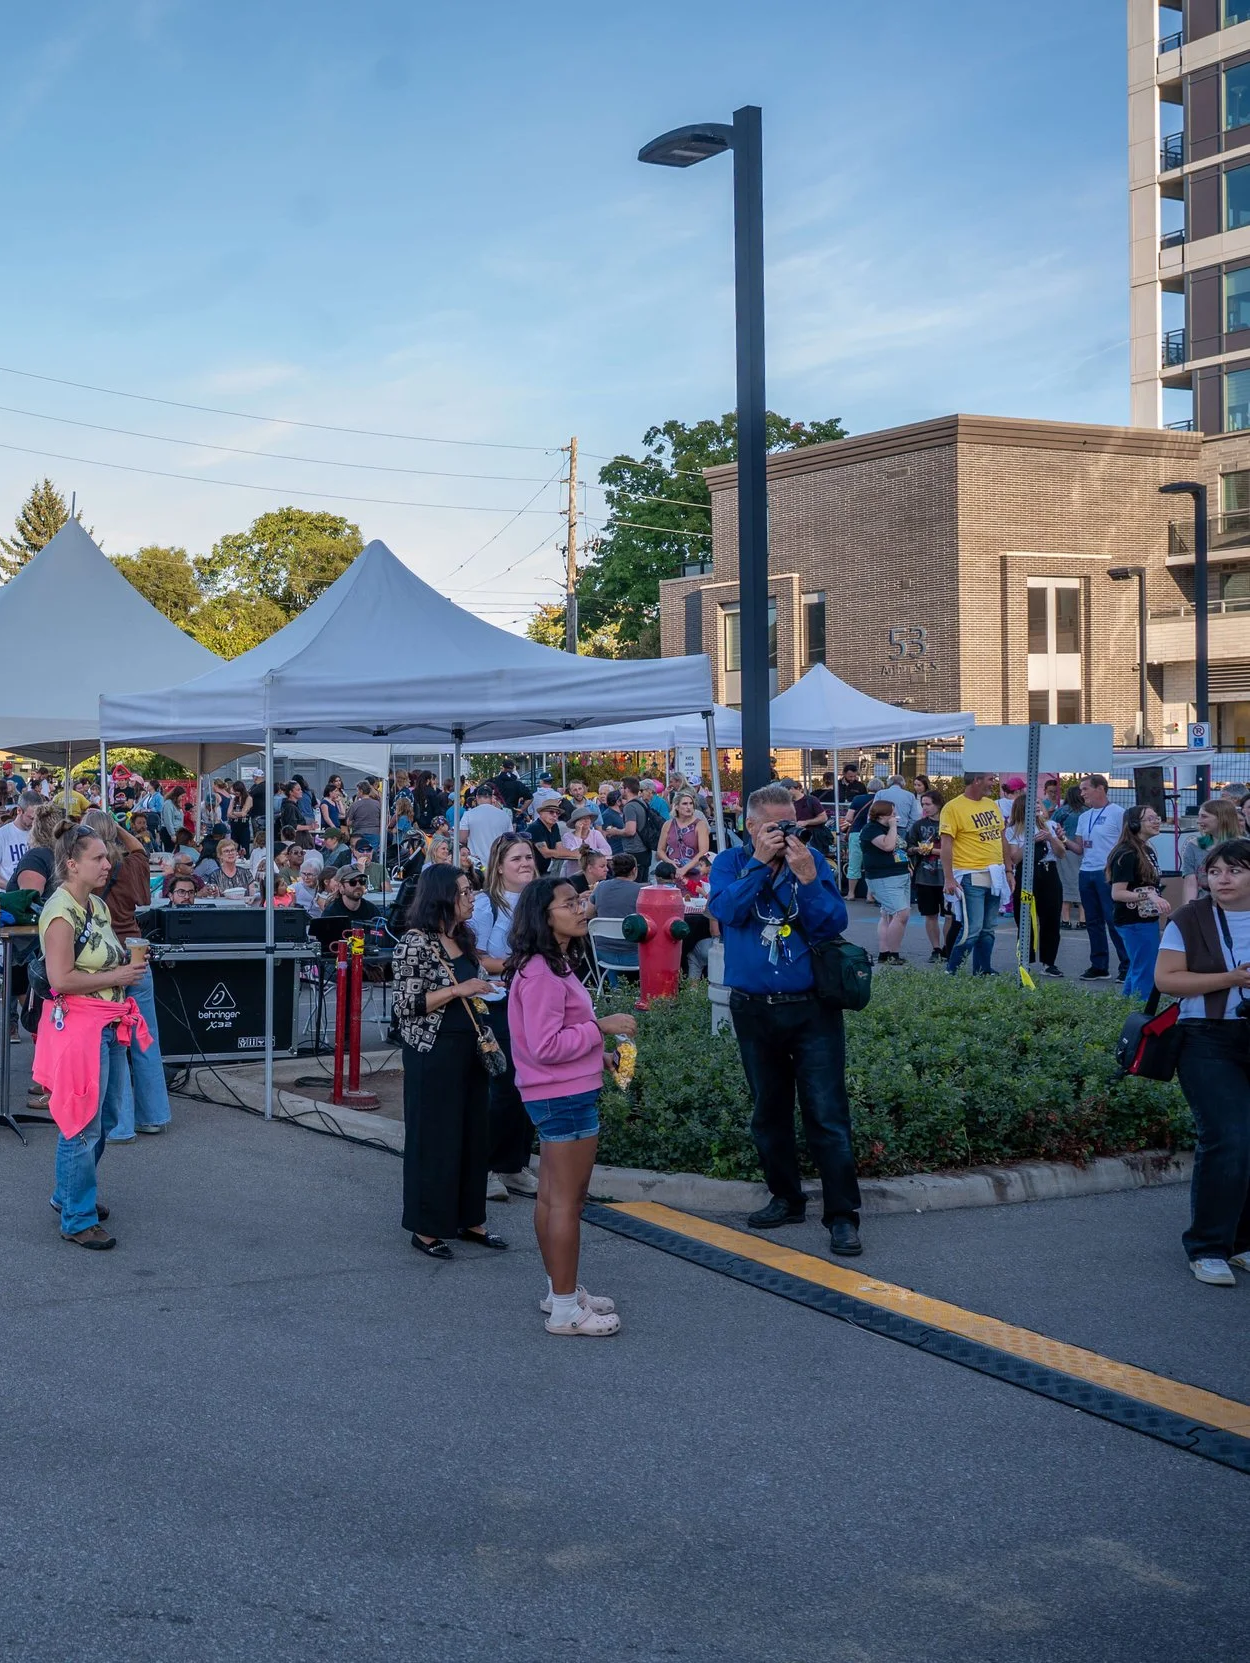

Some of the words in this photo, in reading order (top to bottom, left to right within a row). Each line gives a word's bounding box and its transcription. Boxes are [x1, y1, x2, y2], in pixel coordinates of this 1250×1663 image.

[888, 625, 927, 660] 53
[971, 810, 1000, 829] HOPE
[979, 828, 1002, 842] STREE
[10, 843, 26, 861] HO
[198, 1010, 240, 1020] behringer
[206, 1021, 232, 1031] X32
